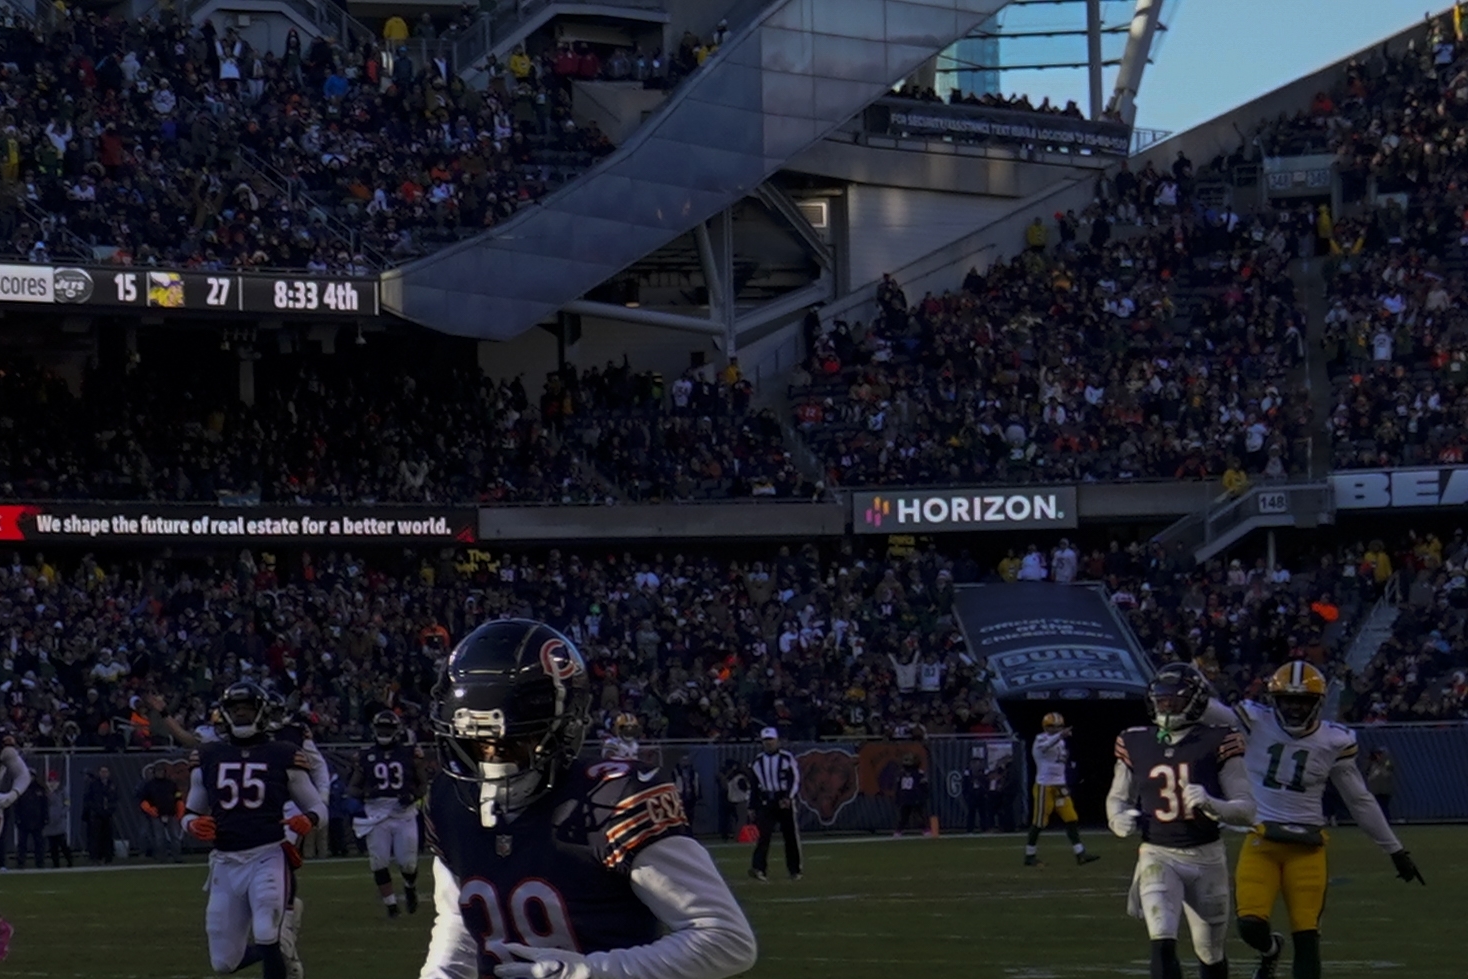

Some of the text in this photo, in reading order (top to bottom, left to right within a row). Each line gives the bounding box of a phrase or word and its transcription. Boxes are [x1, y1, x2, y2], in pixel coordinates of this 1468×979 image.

[114, 272, 137, 302] 15
[206, 276, 231, 306] 27
[274, 280, 359, 311] 8:33 4th
[1260, 495, 1285, 509] 148
[36, 514, 452, 538] We shape the future of real estate for a better world.
[1001, 649, 1115, 667] BUILT
[1010, 668, 1125, 686] TOUGH
[373, 761, 405, 791] 93
[1263, 742, 1310, 793] 11
[216, 761, 269, 811] 55
[1148, 762, 1195, 824] 31
